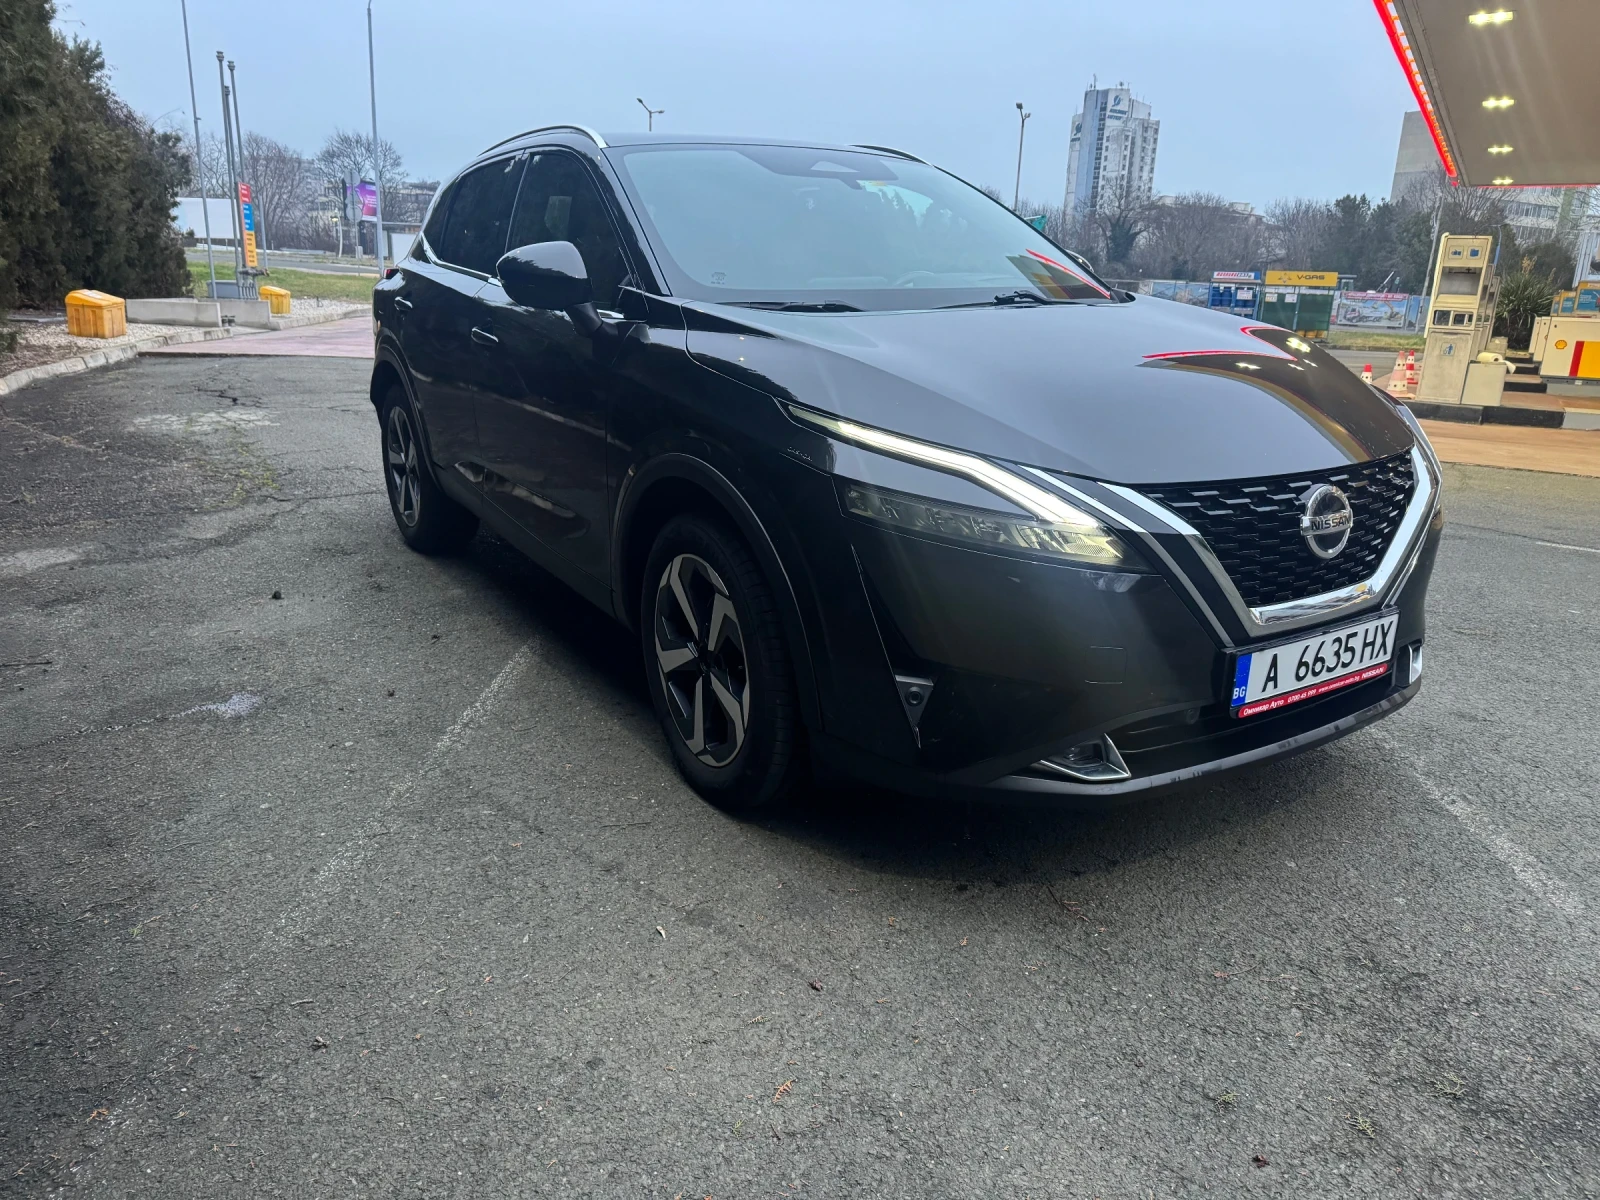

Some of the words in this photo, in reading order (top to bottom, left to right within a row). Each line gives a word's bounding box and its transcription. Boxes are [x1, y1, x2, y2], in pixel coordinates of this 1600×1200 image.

[1311, 515, 1350, 531] NISSAN
[1261, 653, 1279, 693] A
[1295, 631, 1358, 682] 6635
[1233, 686, 1246, 700] BG
[1269, 698, 1284, 711] Ауто
[1361, 667, 1385, 679] NISSAN
